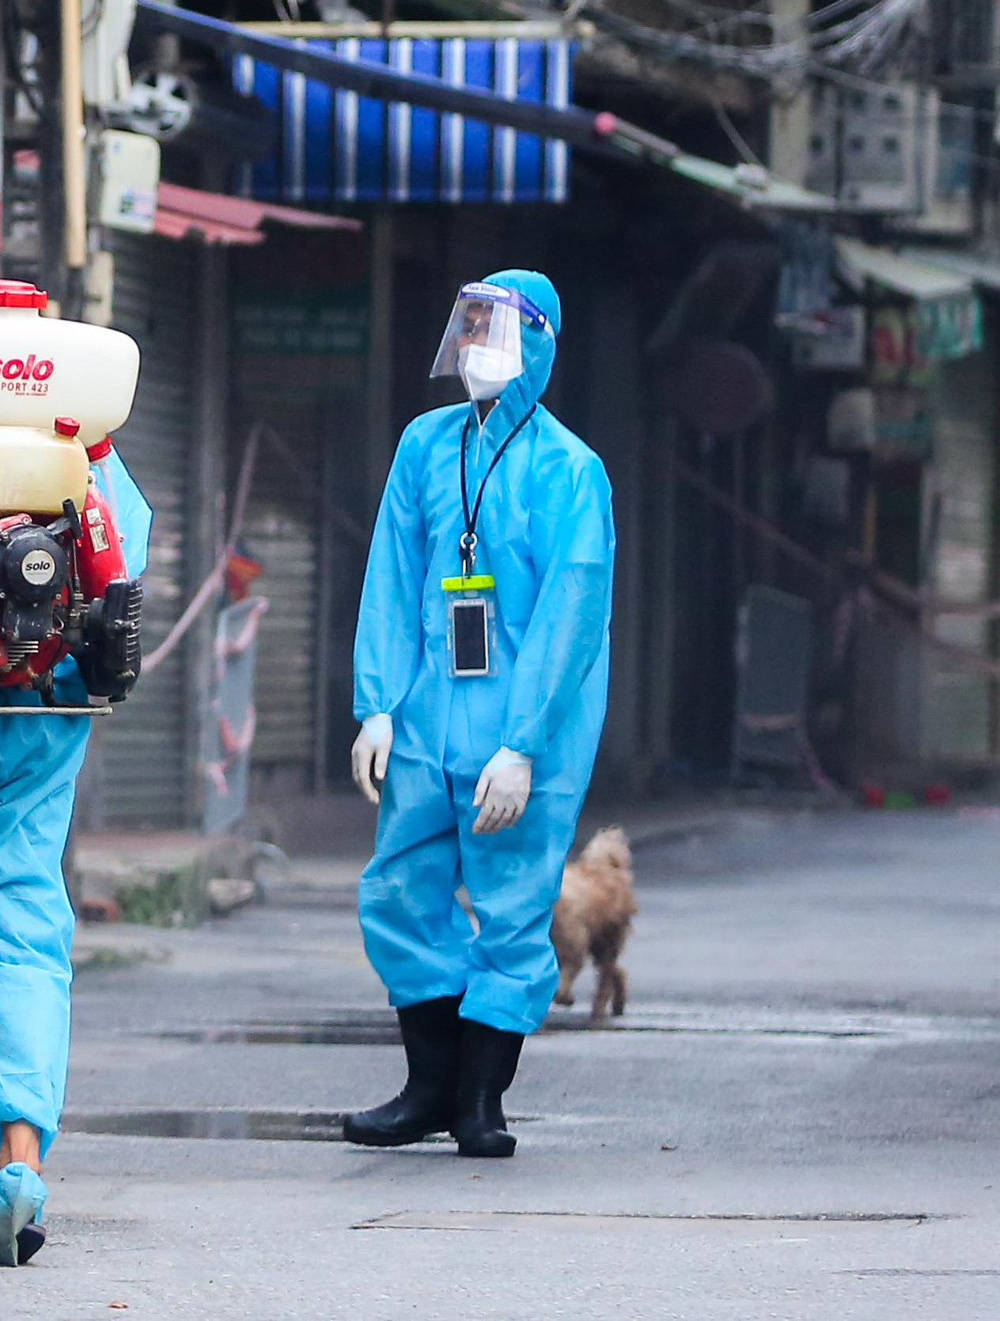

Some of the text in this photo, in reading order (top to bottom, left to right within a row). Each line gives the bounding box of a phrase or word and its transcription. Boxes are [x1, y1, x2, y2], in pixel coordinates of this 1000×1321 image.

[1, 382, 49, 392] PORT 423
[25, 560, 51, 571] solo
